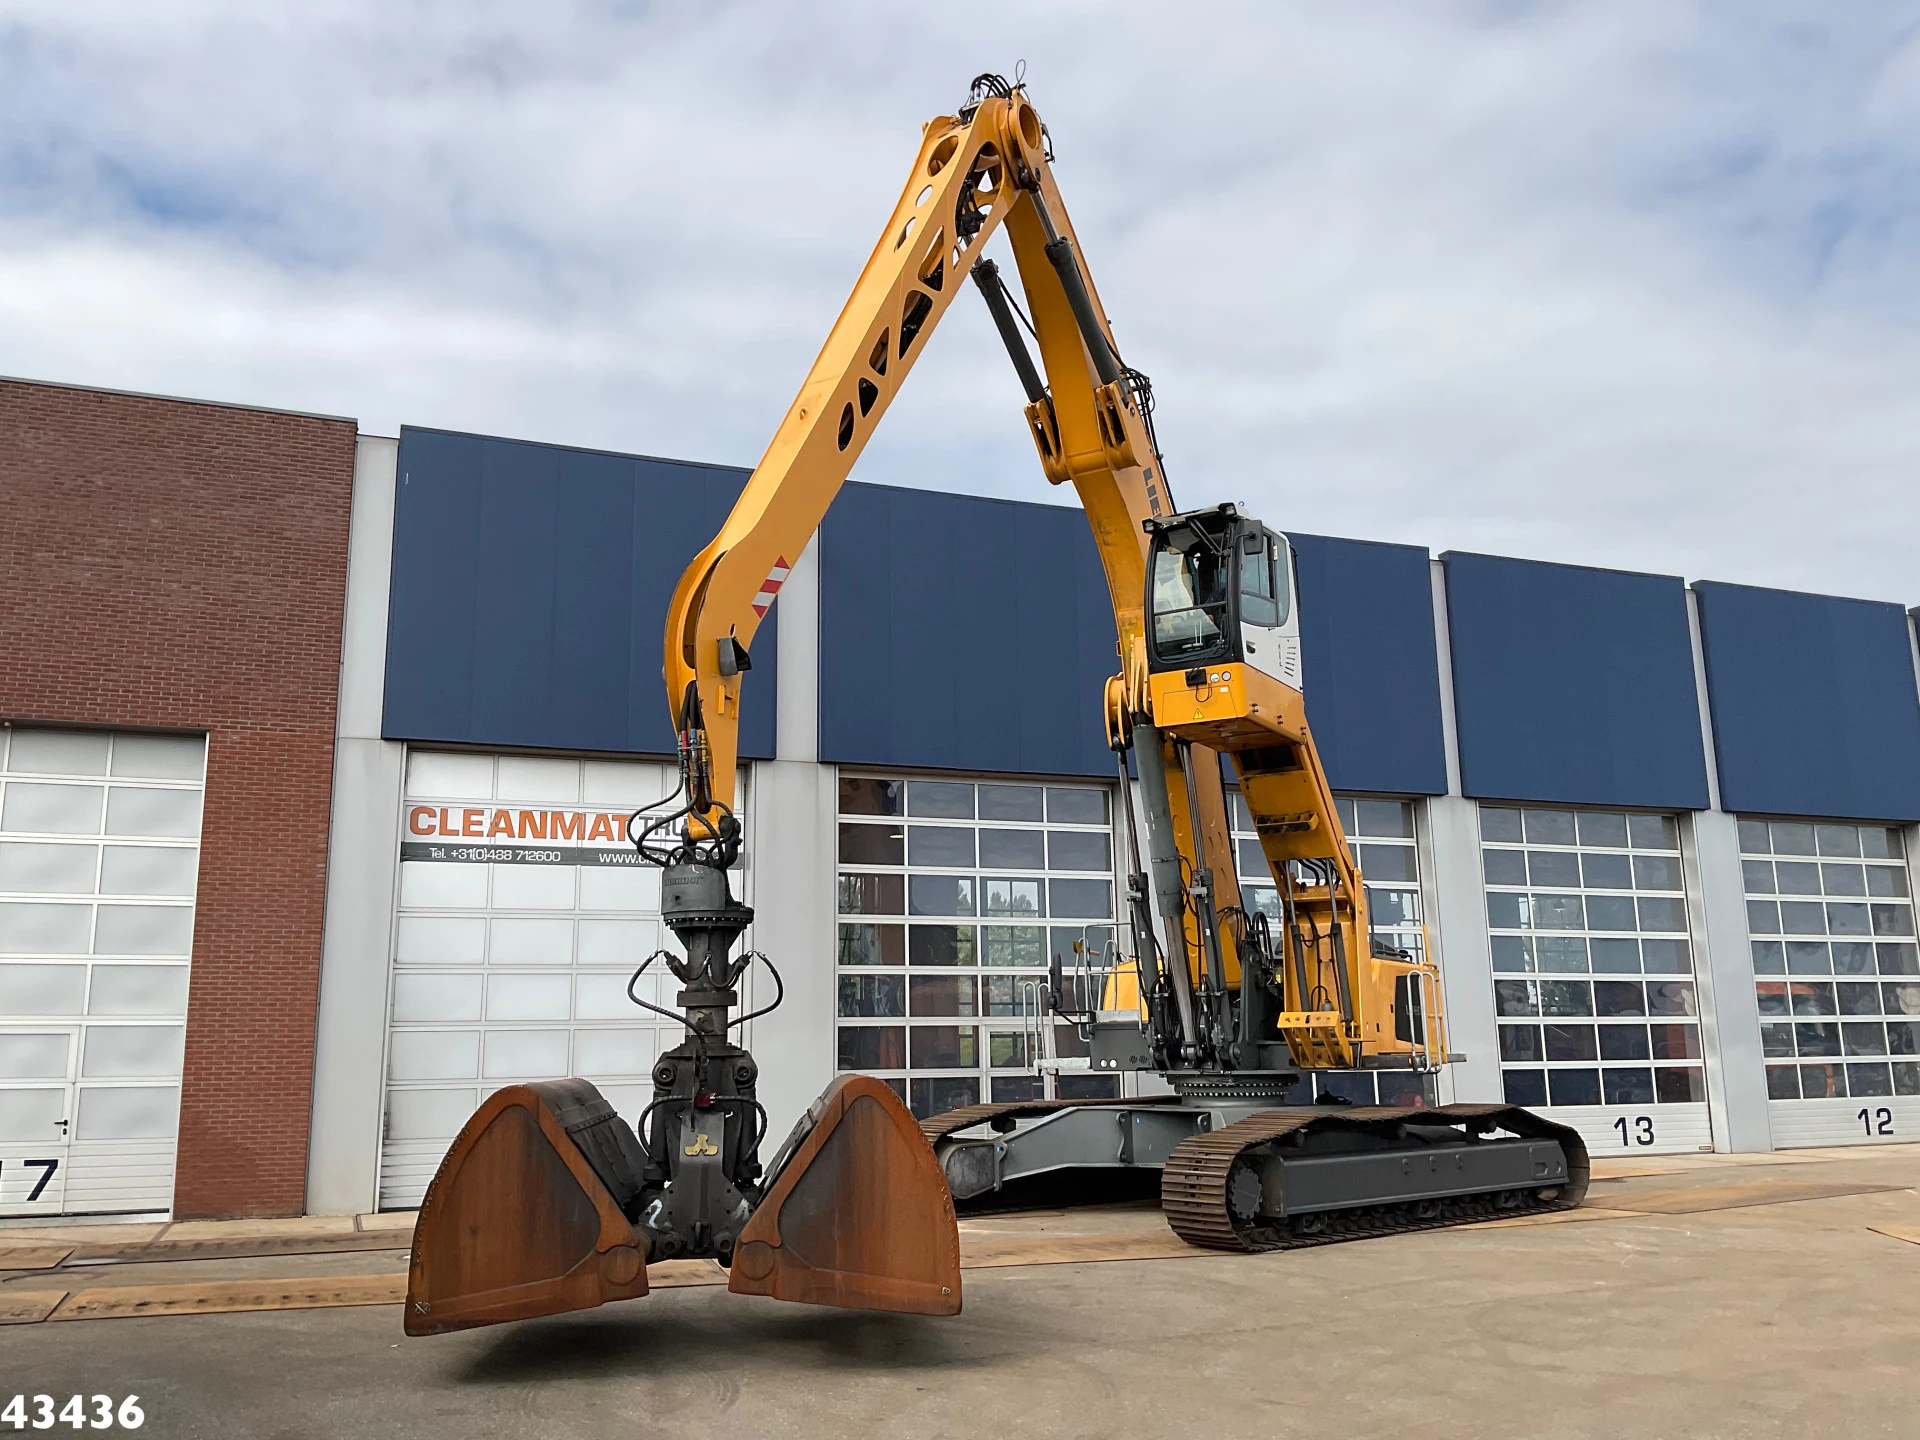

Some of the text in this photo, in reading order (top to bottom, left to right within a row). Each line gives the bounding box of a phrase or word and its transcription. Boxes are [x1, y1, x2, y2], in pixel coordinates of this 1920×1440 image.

[1143, 466, 1163, 519] LIE
[409, 806, 688, 842] CLEANMAT TRU
[429, 847, 447, 859] Tel.
[451, 848, 512, 861] +31(0)488
[516, 850, 561, 862] 712600
[1613, 1116, 1655, 1146] 13
[1857, 1107, 1894, 1136] 12
[0, 1158, 59, 1201] 7
